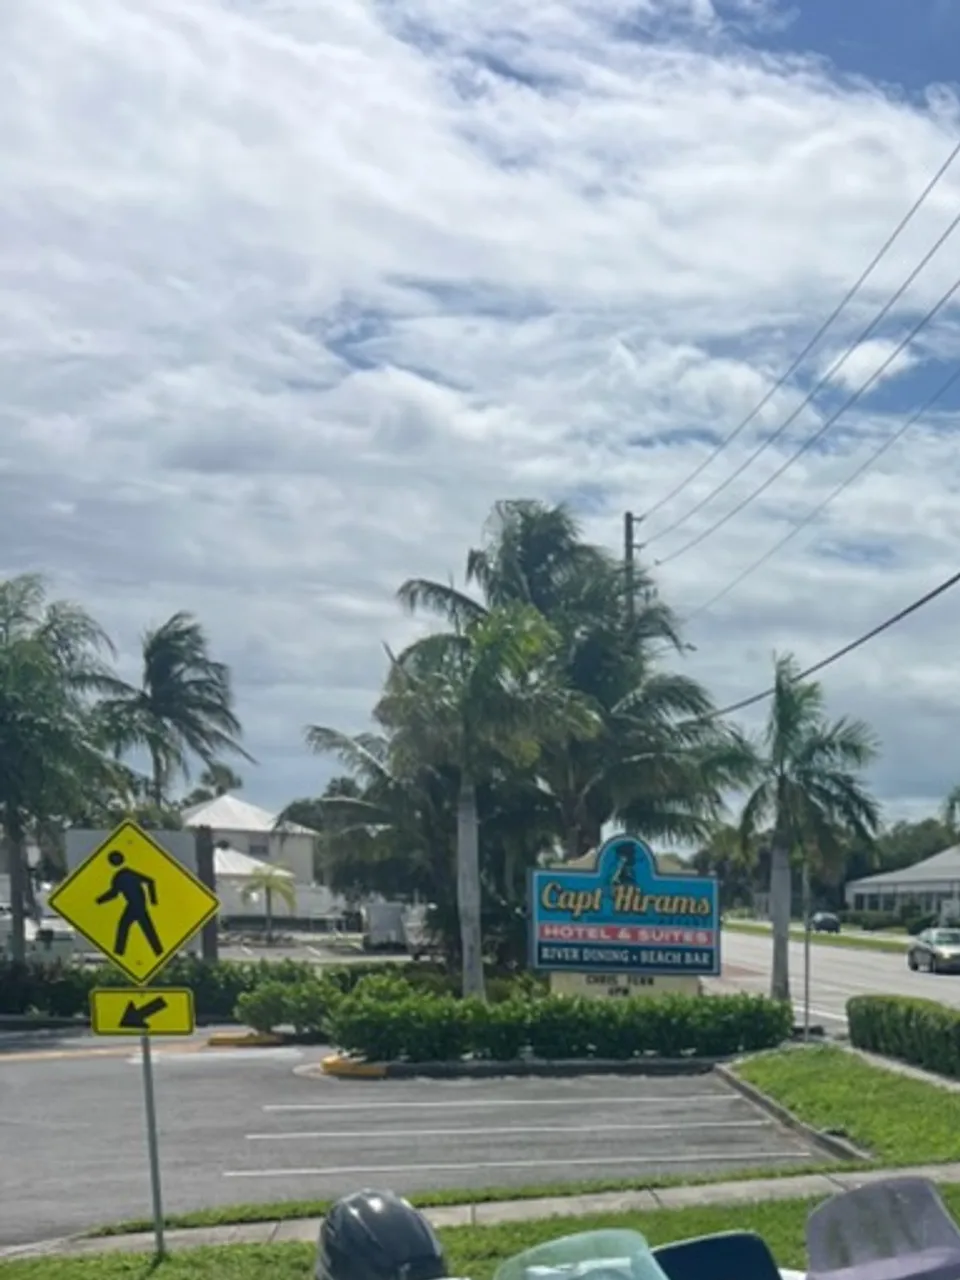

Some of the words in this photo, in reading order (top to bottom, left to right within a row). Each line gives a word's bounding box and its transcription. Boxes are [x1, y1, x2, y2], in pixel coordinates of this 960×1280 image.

[541, 881, 602, 918] Capt
[612, 884, 711, 915] Hirams
[543, 925, 611, 940] HOTEL
[618, 928, 631, 940] &
[637, 928, 709, 943] SUITES
[541, 947, 579, 962] RIVER
[583, 949, 629, 963] DINING
[640, 951, 682, 964] BEACH
[684, 952, 710, 965] BAR
